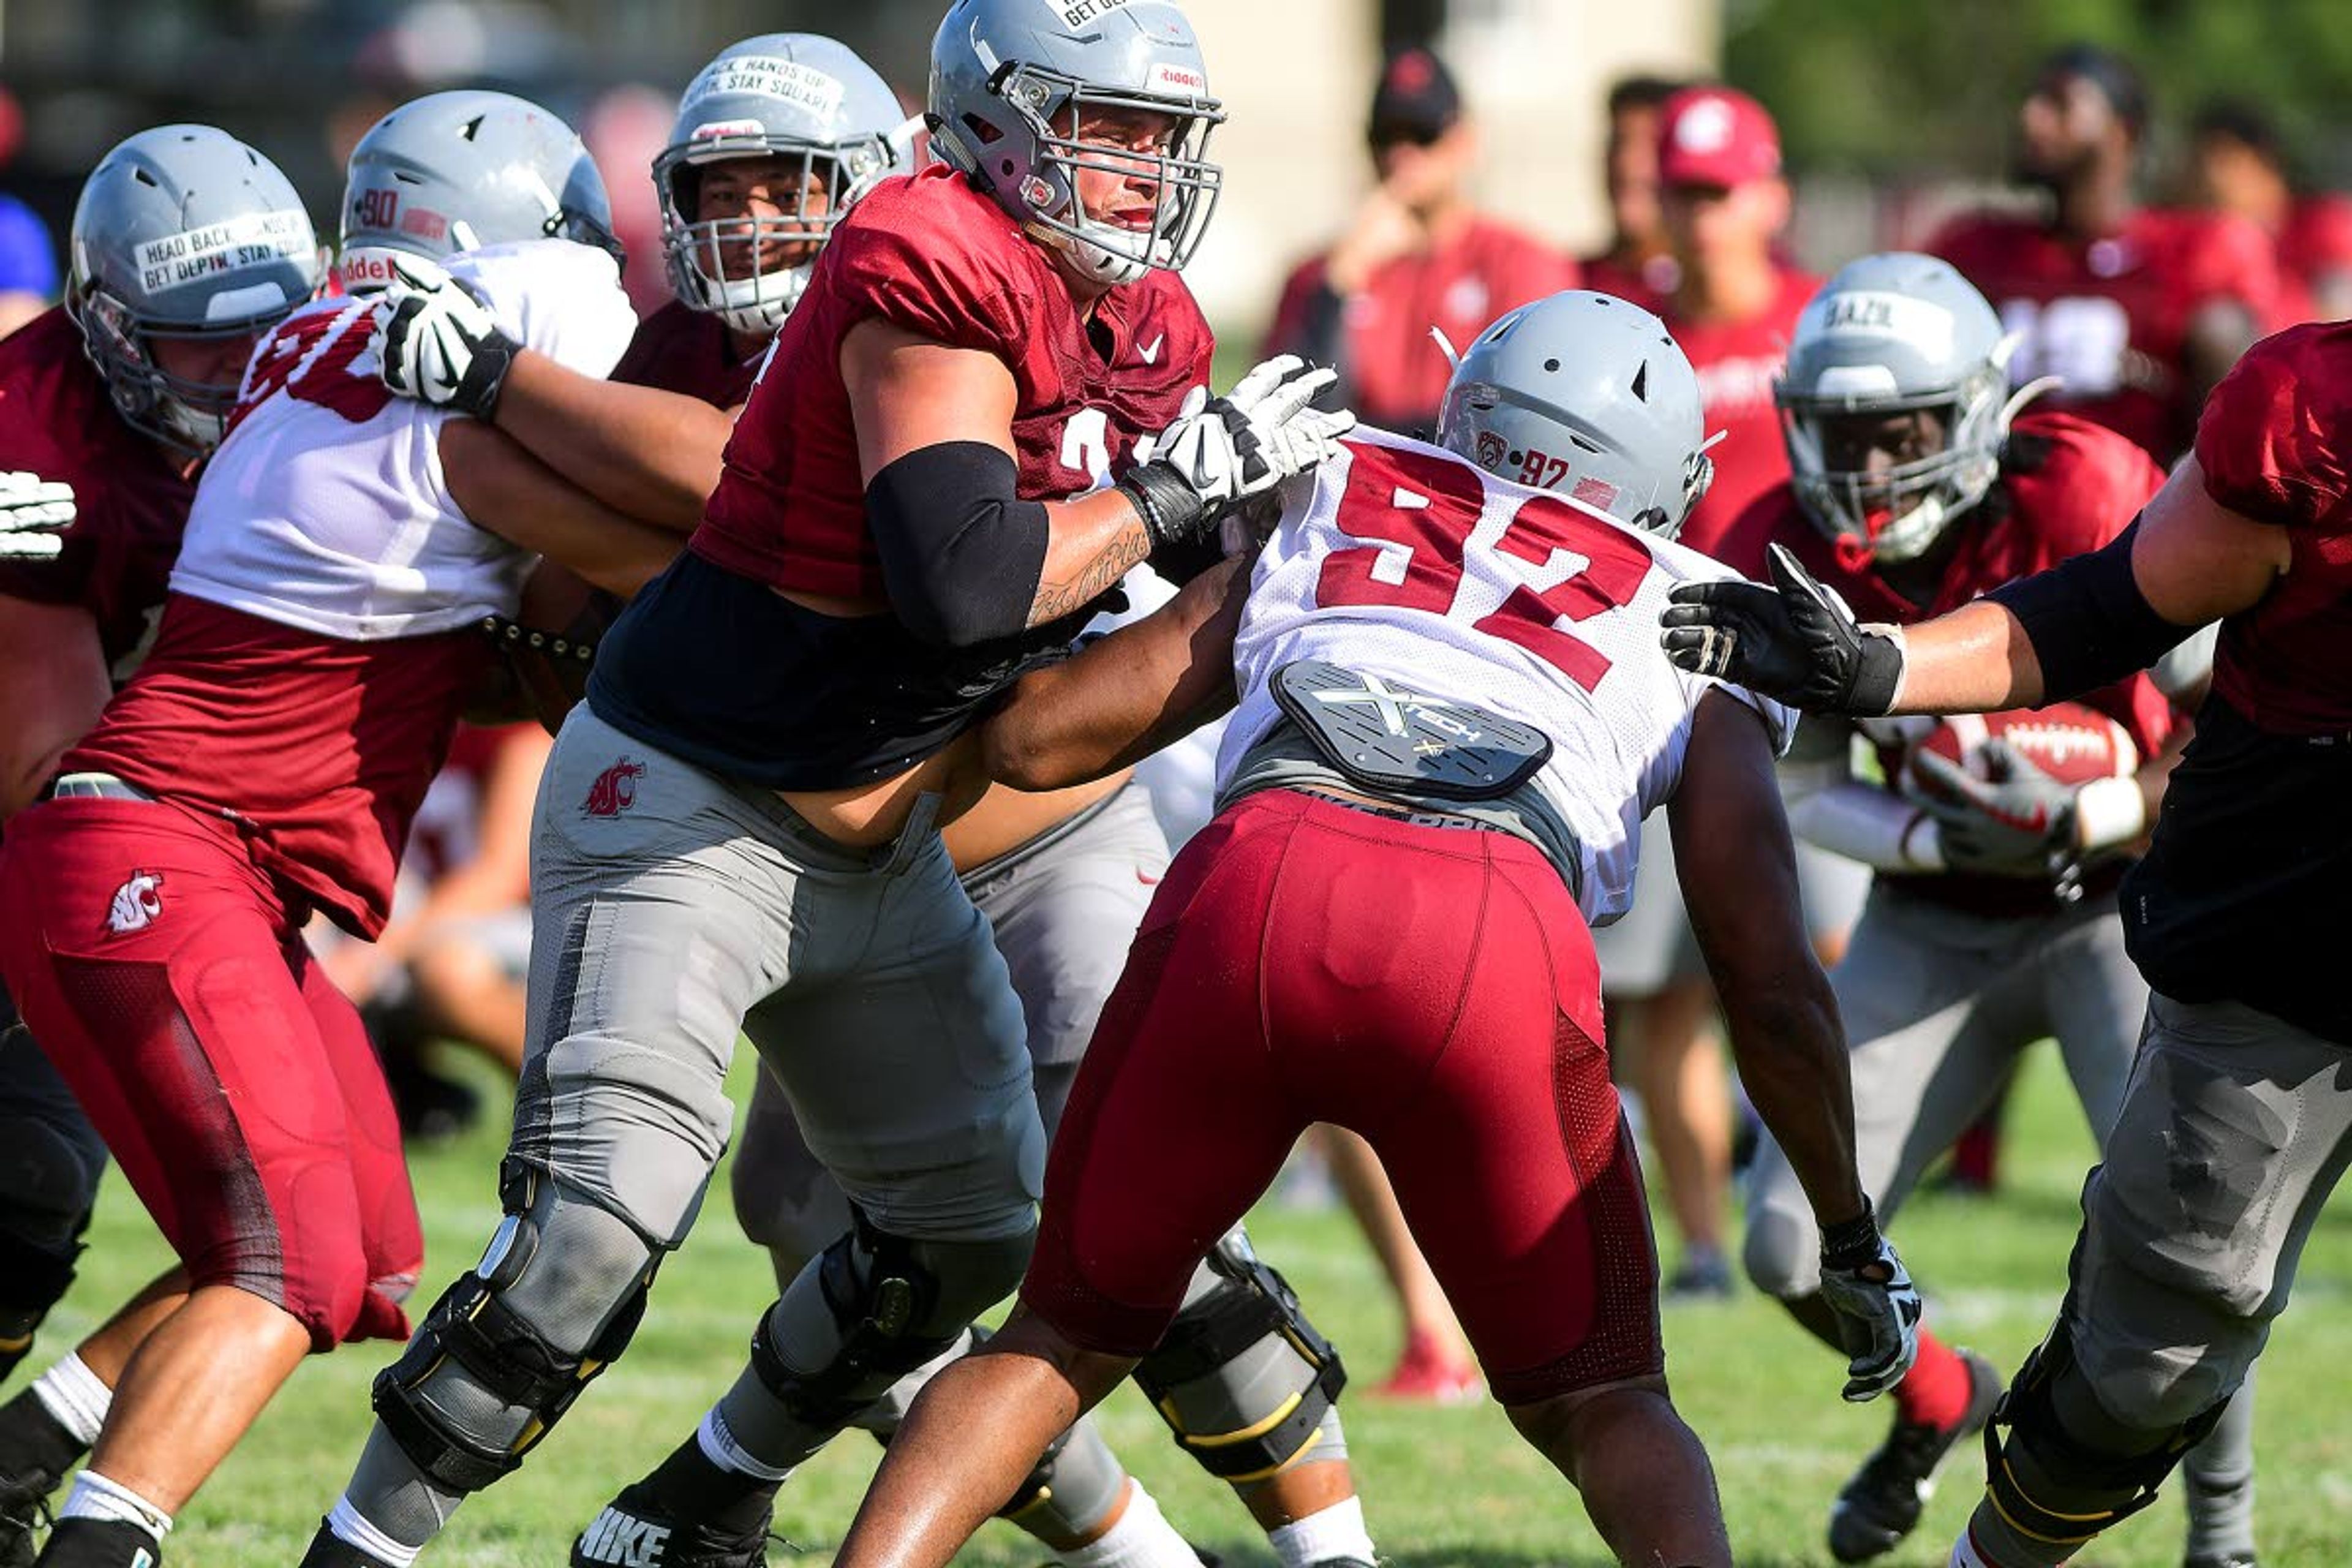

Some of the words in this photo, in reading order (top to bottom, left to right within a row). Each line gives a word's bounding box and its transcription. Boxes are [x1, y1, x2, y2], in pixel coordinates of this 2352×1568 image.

[1065, 2, 1096, 26] GET
[727, 74, 765, 91] STAY
[745, 61, 797, 79] HANDS
[361, 188, 398, 228] 90
[145, 266, 172, 290] GET
[238, 244, 271, 264] STAY
[146, 236, 186, 264] HEAD
[1519, 449, 1569, 489] 92
[1316, 439, 1653, 693] 92
[579, 1506, 672, 1568] NIKE
